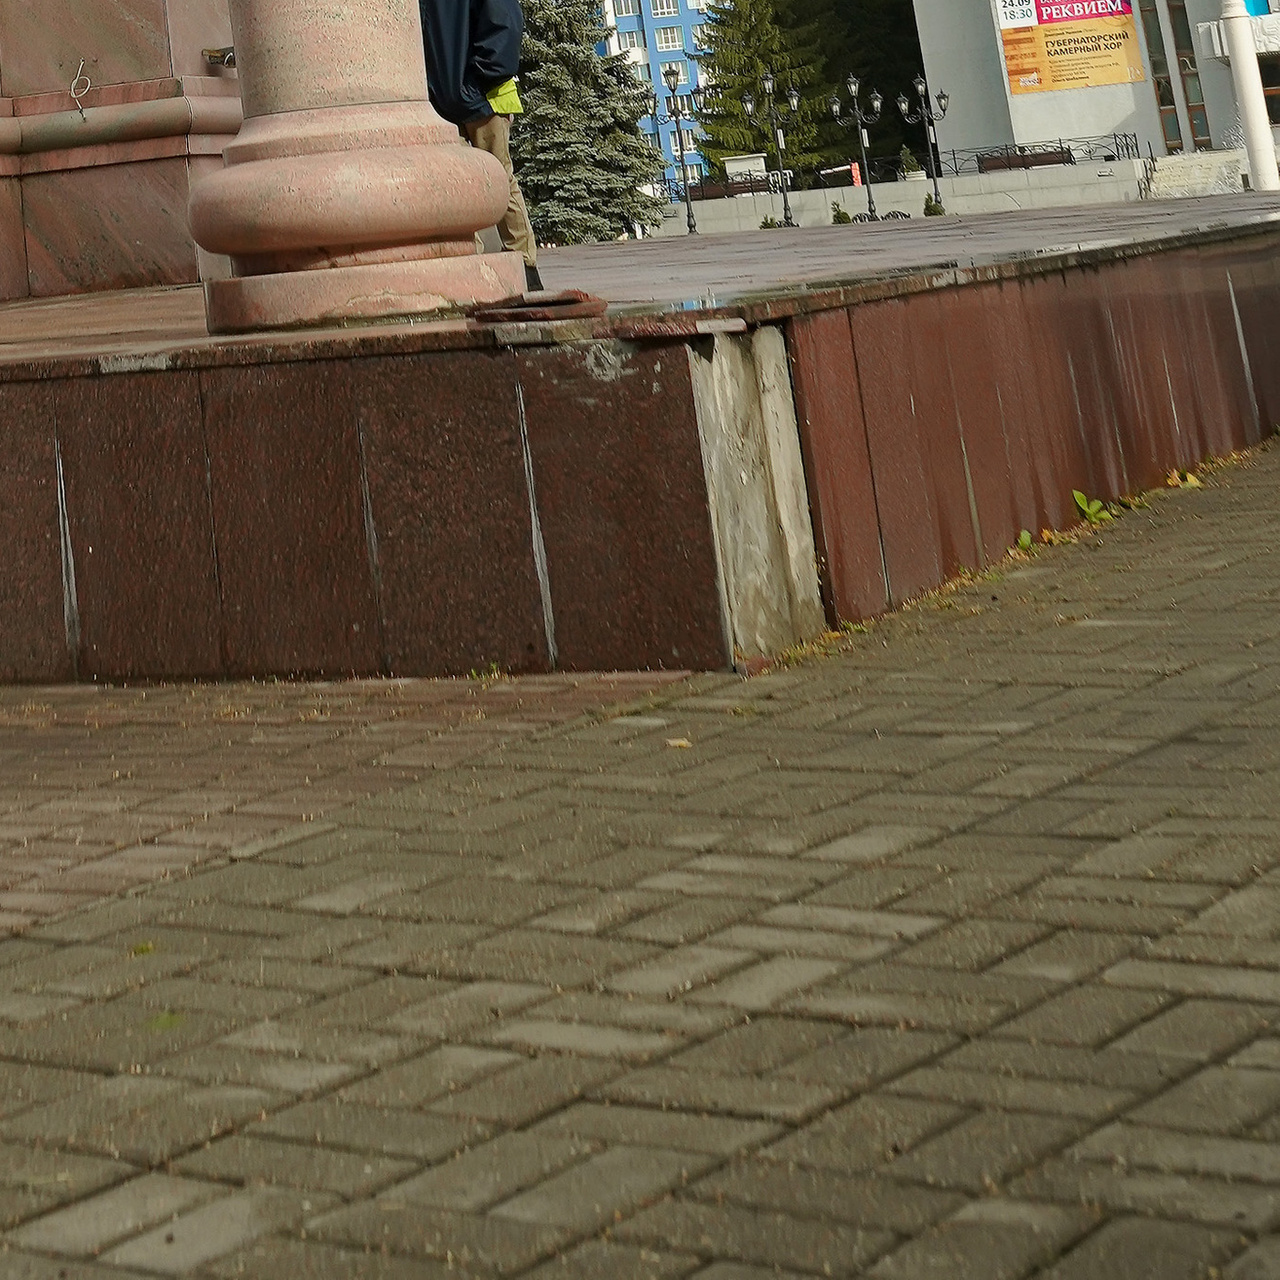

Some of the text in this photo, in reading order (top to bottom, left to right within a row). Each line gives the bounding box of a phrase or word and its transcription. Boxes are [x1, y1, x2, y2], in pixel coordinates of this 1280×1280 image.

[1003, 8, 1033, 20] 18:30
[1045, 31, 1129, 48] ГУБЕРНАТОРСКИЙ
[1046, 41, 1123, 57] КАМЕРНЫЙ ХОР
